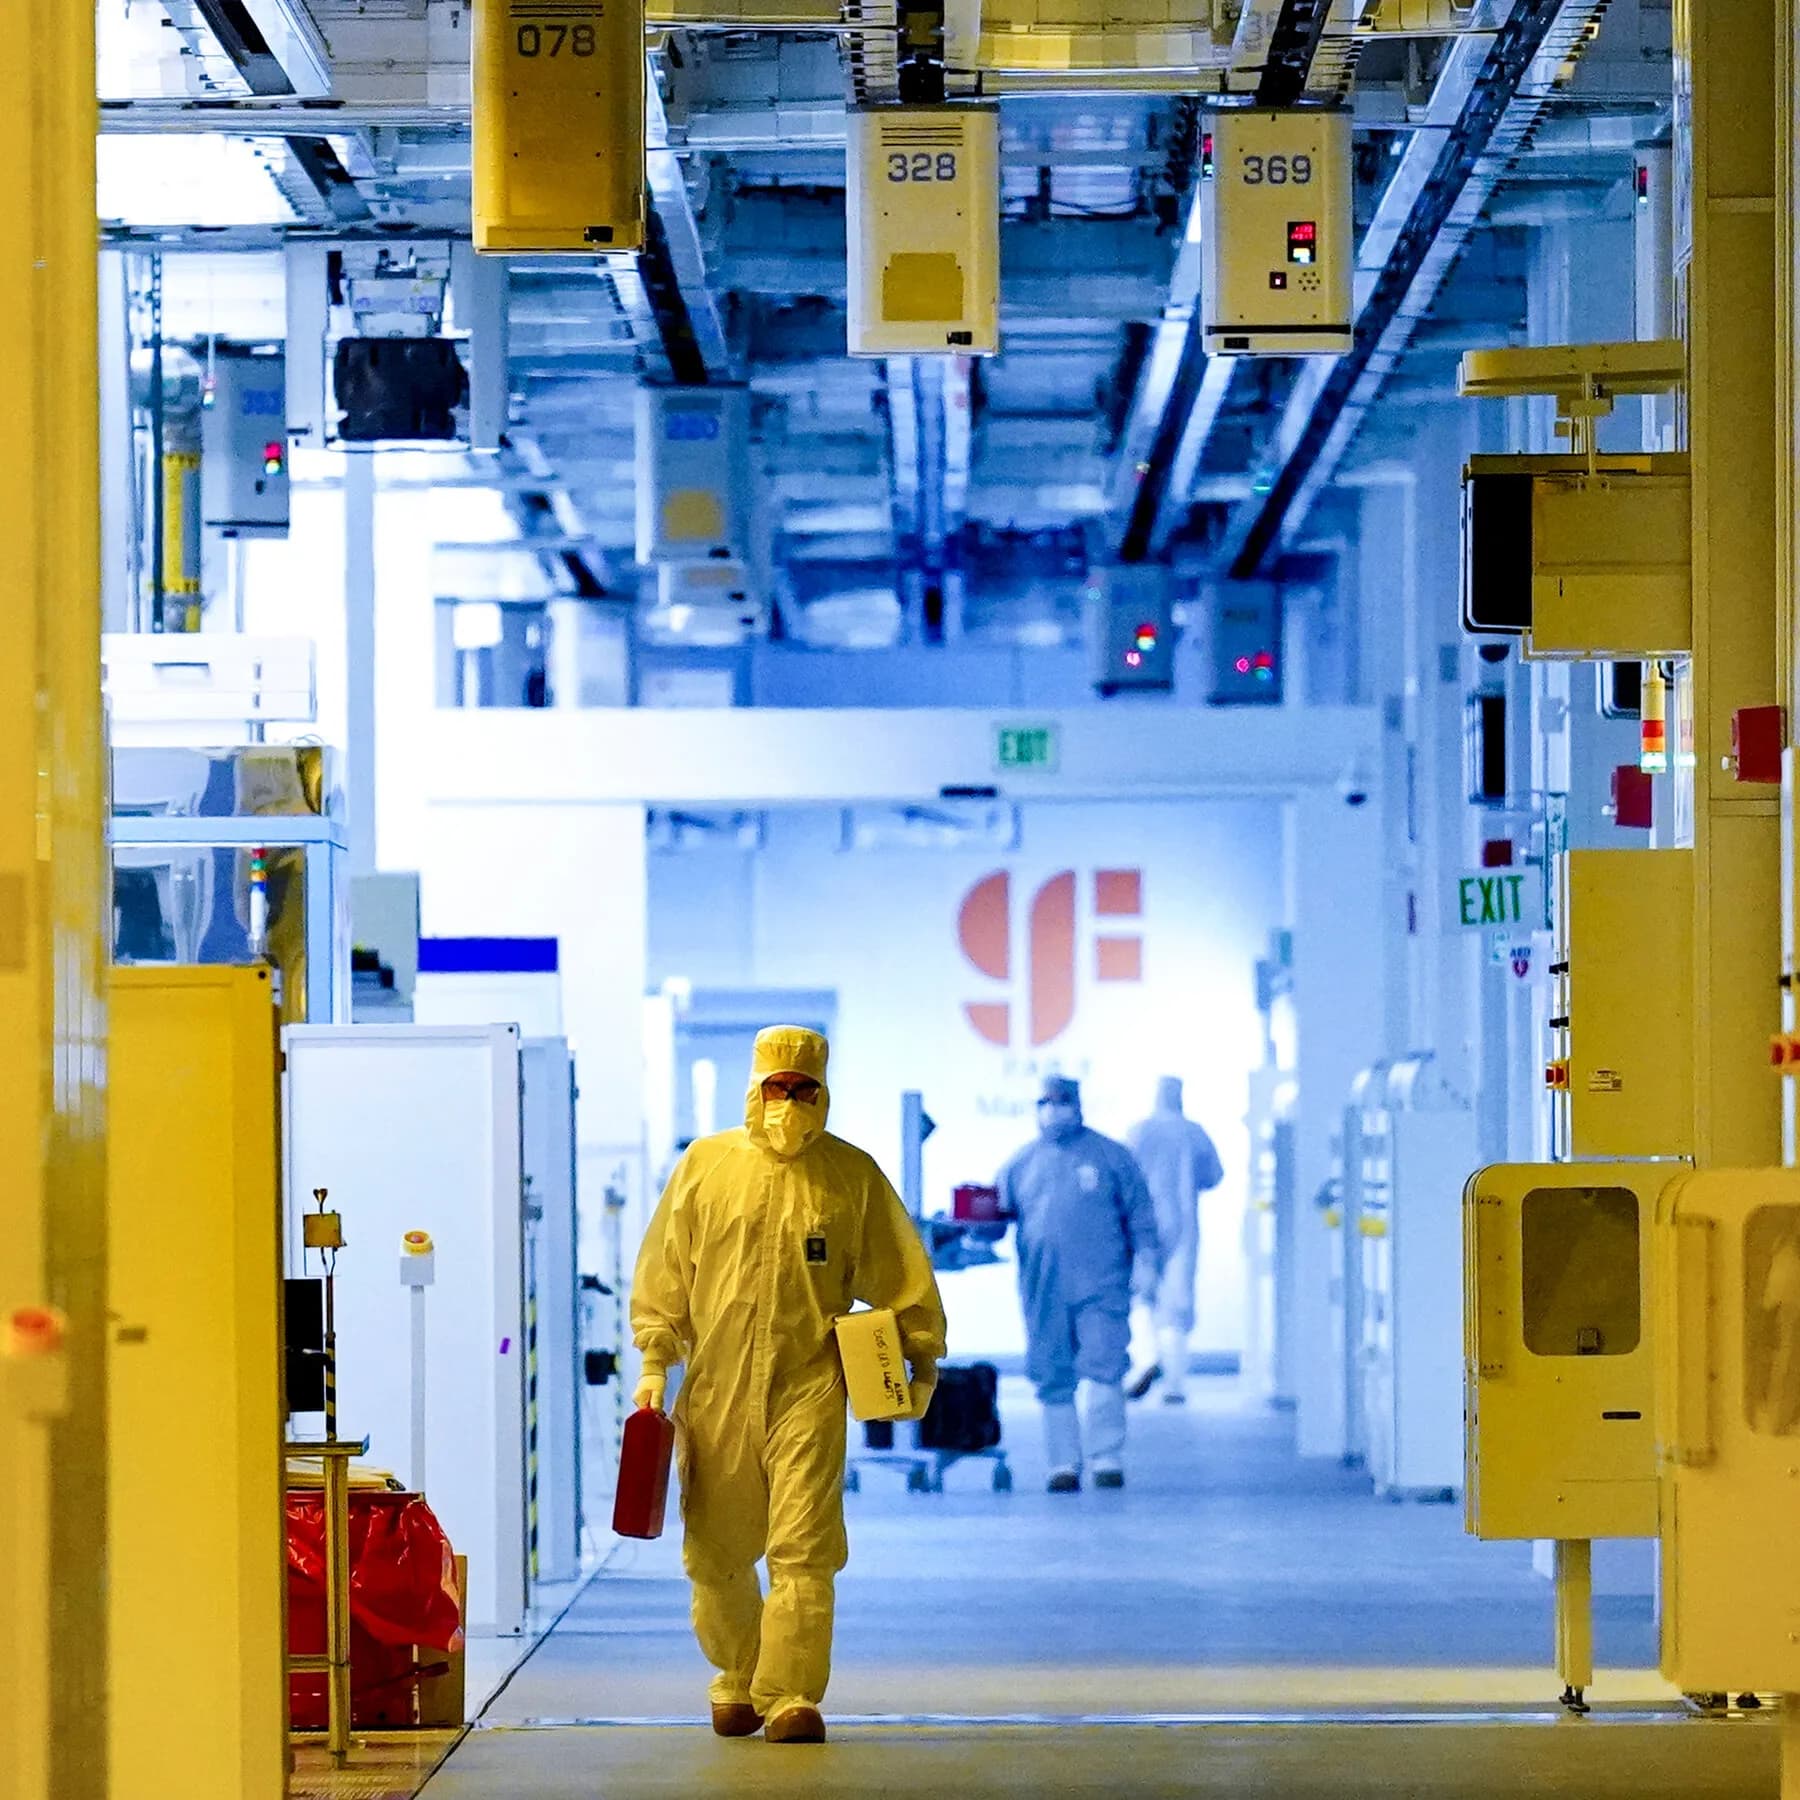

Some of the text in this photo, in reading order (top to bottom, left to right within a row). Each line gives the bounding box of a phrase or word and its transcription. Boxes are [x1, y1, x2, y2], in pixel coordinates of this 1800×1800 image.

[517, 24, 596, 58] 078
[888, 153, 956, 182] 328
[1243, 155, 1311, 184] 369
[999, 728, 1050, 764] EXIT
[1460, 875, 1524, 925] EXIT
